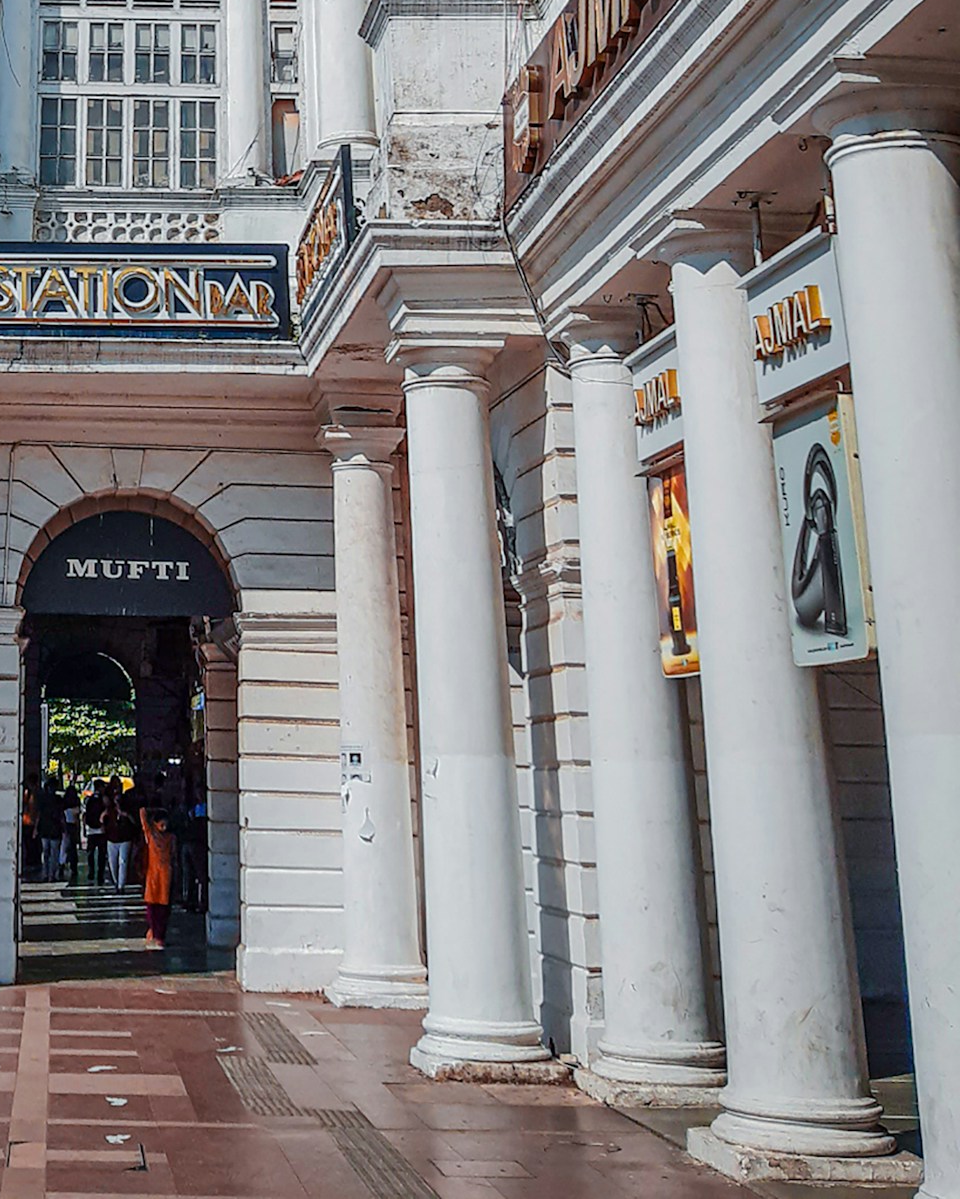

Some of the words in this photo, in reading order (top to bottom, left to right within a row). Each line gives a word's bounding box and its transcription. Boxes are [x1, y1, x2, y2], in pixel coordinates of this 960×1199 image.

[754, 285, 831, 360] AJMAL
[634, 369, 681, 426] AJMAL
[66, 558, 189, 580] MUFTI
